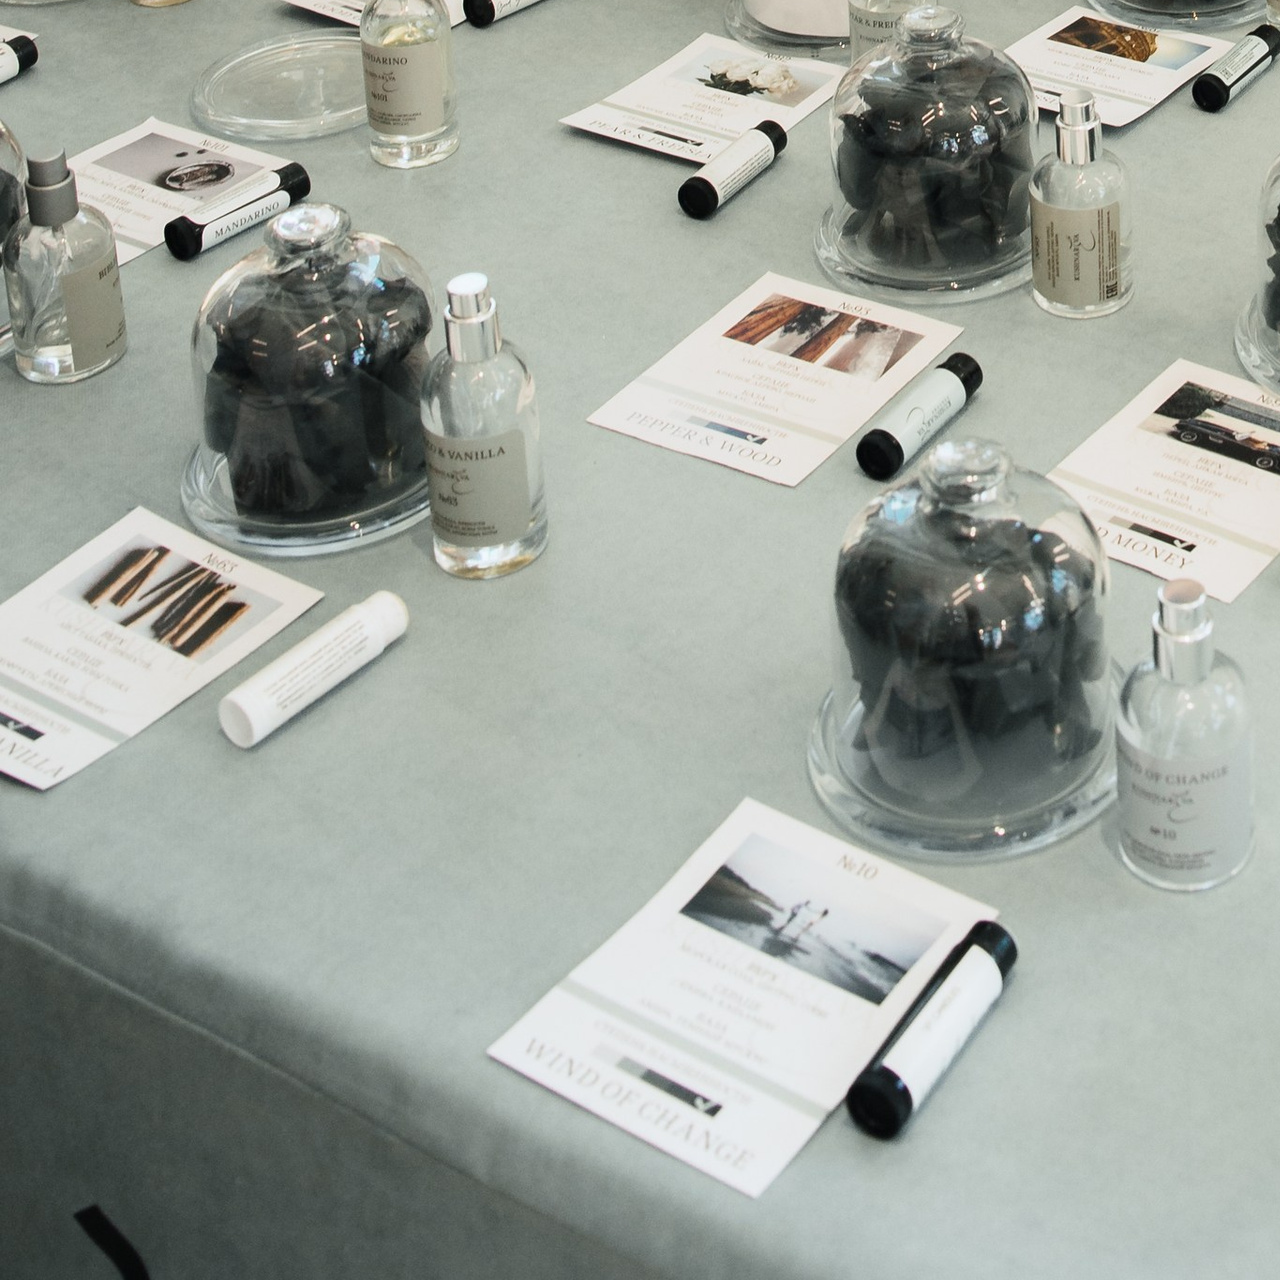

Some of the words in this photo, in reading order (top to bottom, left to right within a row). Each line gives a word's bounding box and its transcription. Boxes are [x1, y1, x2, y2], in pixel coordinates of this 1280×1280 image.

[214, 200, 281, 239] MANDARINO
[447, 446, 506, 462] VANILLA
[625, 411, 697, 442] PEPPER
[698, 434, 714, 448] &
[718, 436, 785, 469] WOOD
[1112, 532, 1196, 571] MONEY
[1166, 765, 1230, 787] CHANGE
[836, 851, 879, 881] №10
[524, 1037, 600, 1090] WIND
[599, 1072, 640, 1108] OF
[636, 1096, 757, 1172] CHANGE
